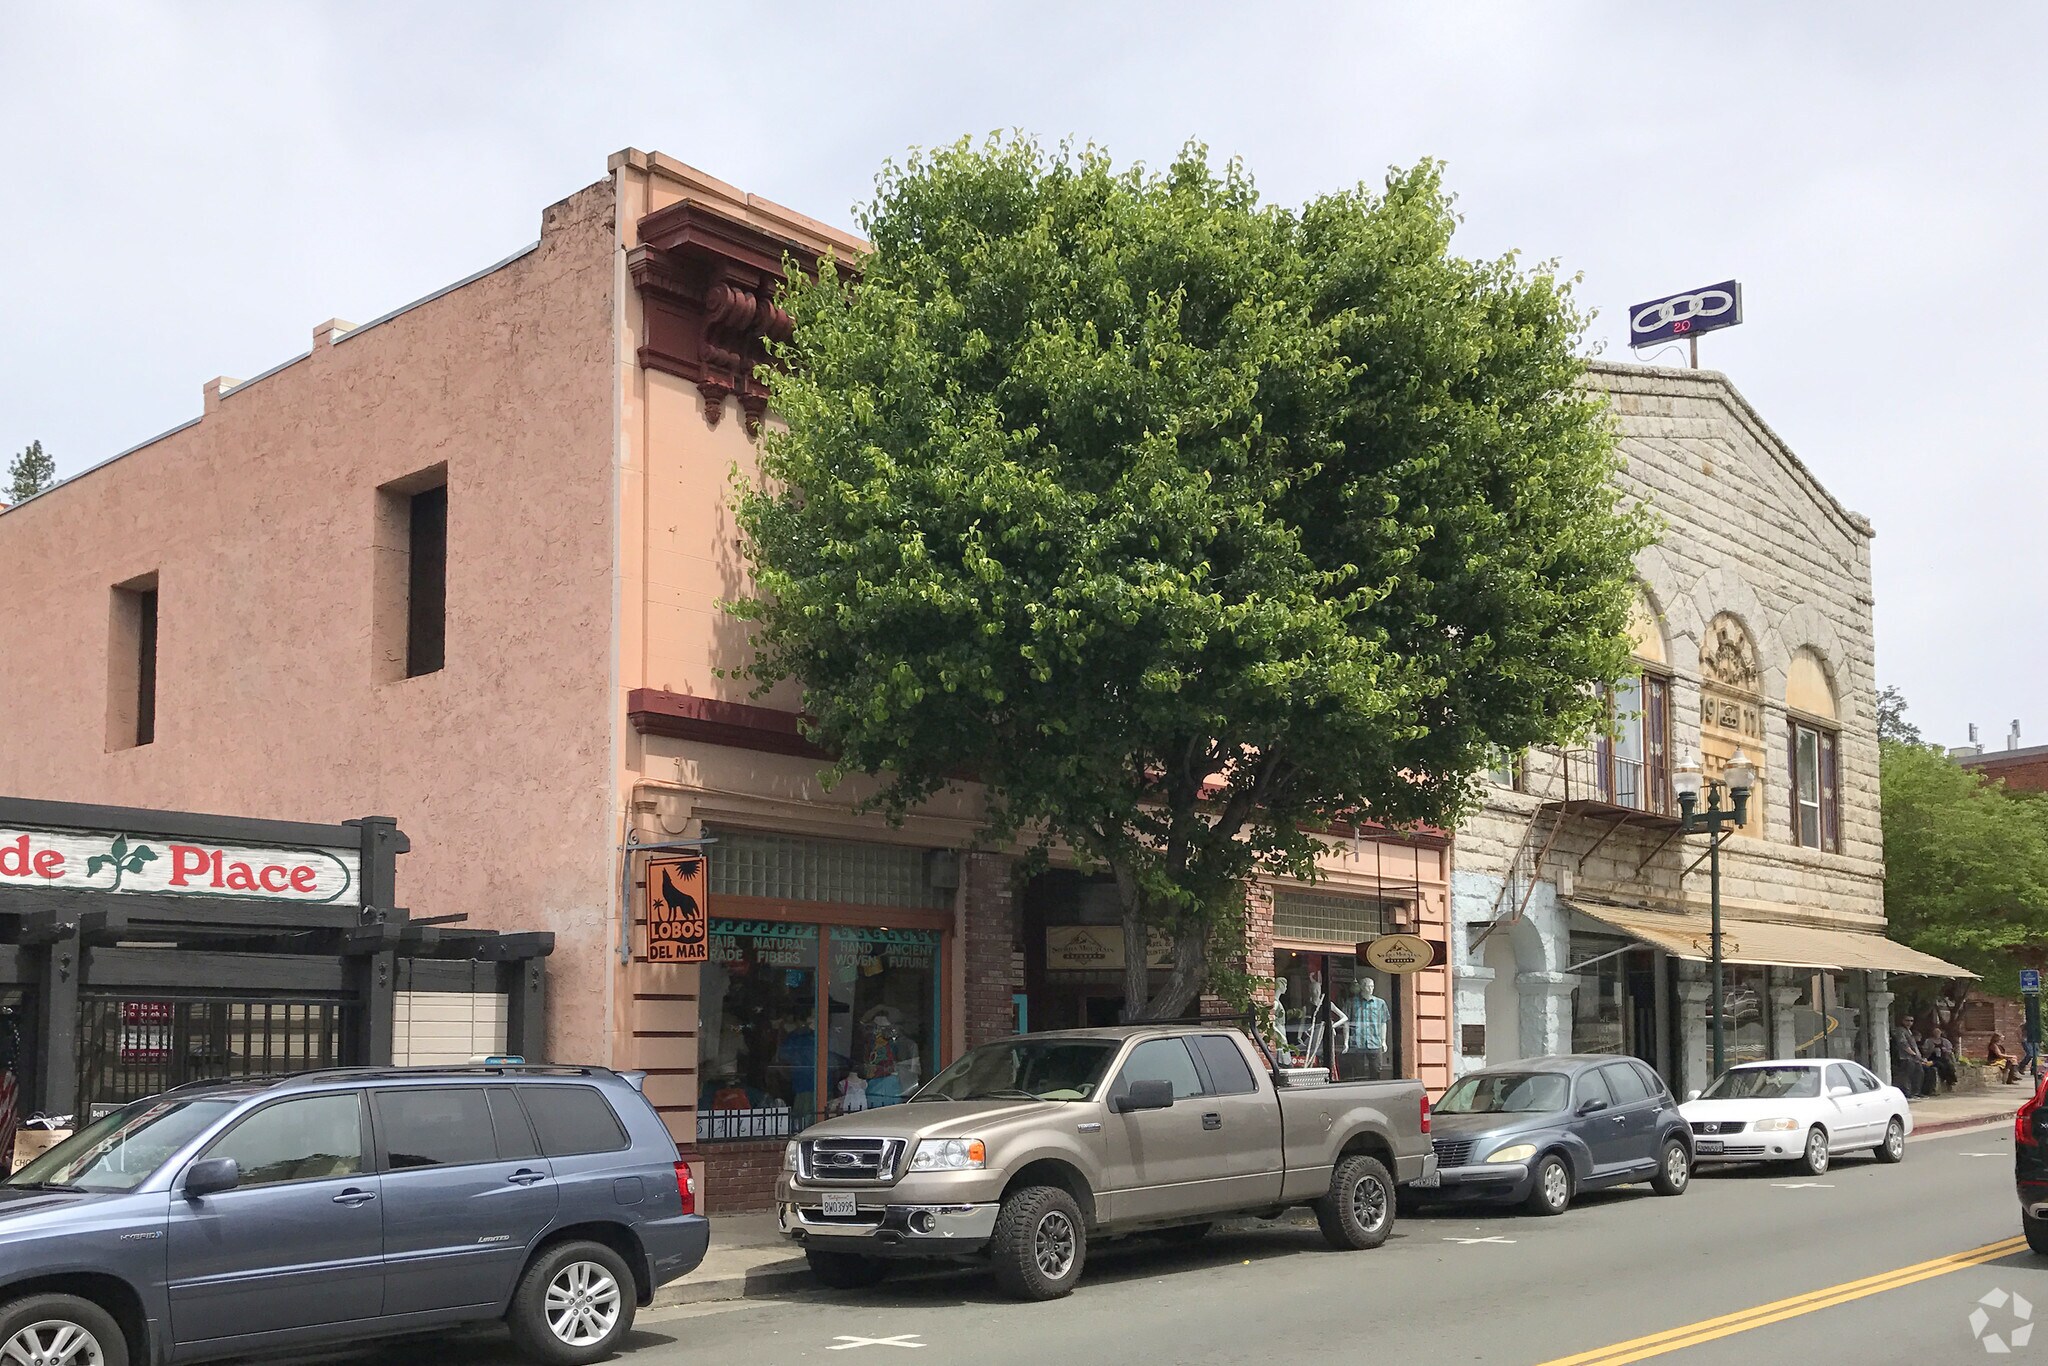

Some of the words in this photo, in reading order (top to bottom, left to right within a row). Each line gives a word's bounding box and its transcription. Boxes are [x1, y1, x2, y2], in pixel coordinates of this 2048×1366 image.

[0, 834, 66, 879] de
[168, 844, 317, 893] Place
[650, 920, 704, 939] LOBOS
[753, 936, 807, 950] NATURAL
[840, 941, 873, 954] HAND
[885, 943, 933, 956] ANCIENT
[650, 945, 673, 960] DEL
[676, 943, 706, 959] MAR
[709, 949, 743, 962] RADE
[757, 950, 801, 964] FIBERS
[835, 953, 877, 967] WOVEN
[889, 956, 929, 969] FUTURE
[92, 1110, 104, 1118] Bell
